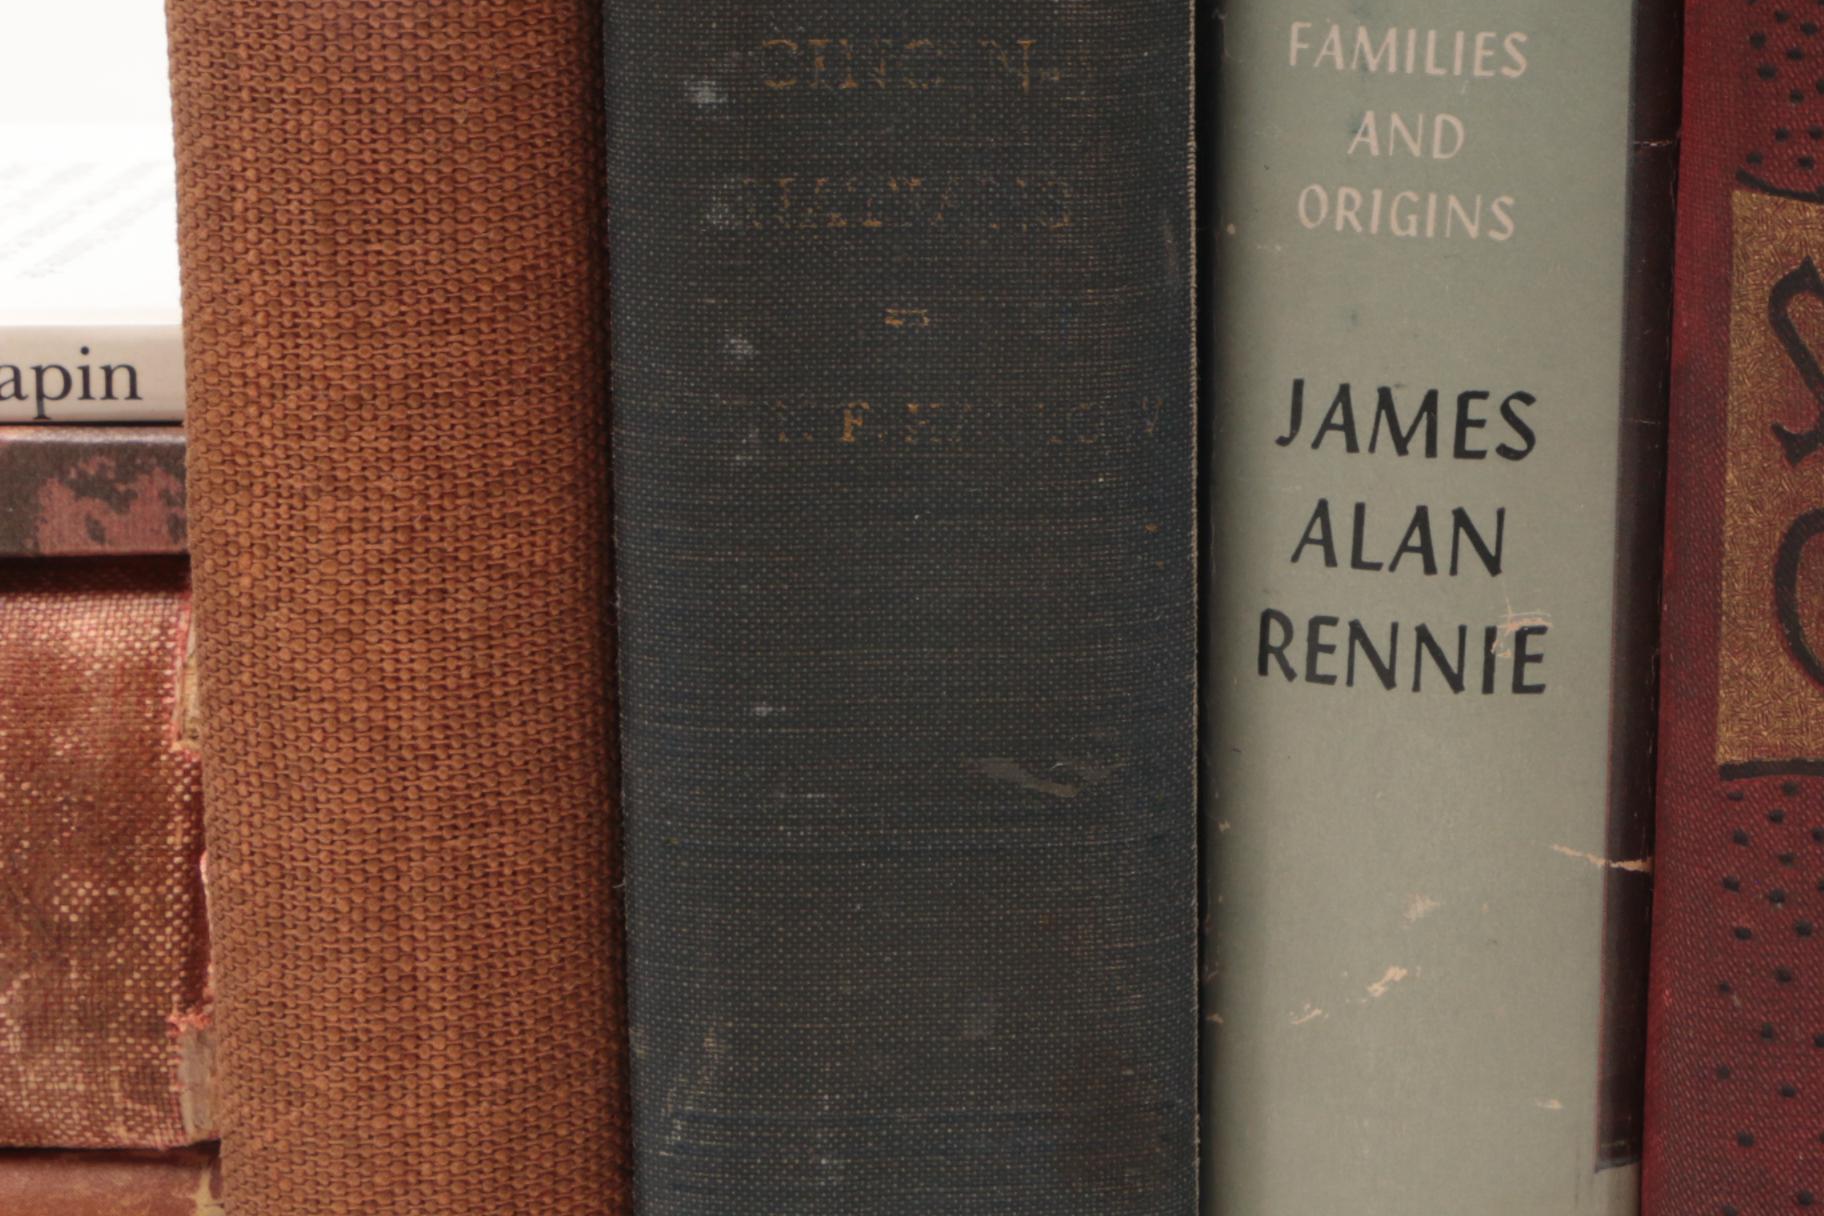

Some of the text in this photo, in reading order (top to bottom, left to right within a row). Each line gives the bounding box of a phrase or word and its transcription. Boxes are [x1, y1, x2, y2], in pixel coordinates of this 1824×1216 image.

[1289, 21, 1529, 79] FAMILIES
[1346, 110, 1466, 160] AND
[1298, 184, 1516, 242] ORIGINS
[1274, 378, 1538, 462] JAMES
[1290, 497, 1505, 577] ALAN
[1257, 607, 1549, 695] RENNIE
